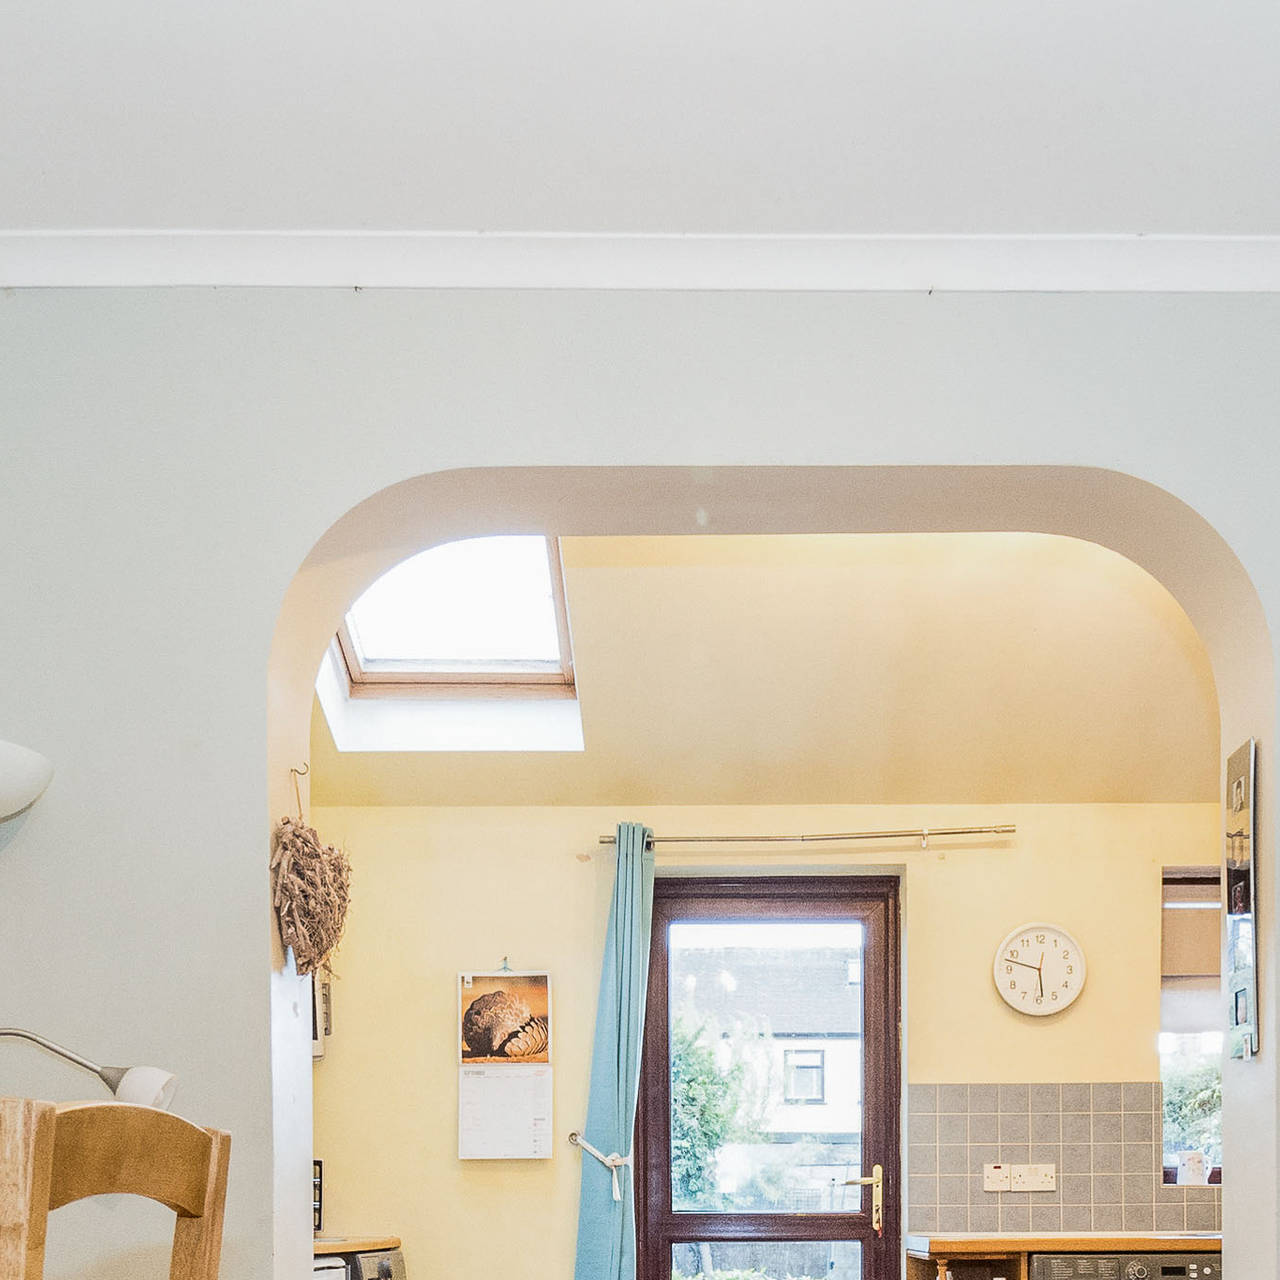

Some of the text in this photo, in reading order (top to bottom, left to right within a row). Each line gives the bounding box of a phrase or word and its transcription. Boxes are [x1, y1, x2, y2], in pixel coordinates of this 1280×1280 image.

[1021, 939, 1029, 948] 11
[1035, 935, 1045, 944] 12
[1009, 950, 1019, 959] 10
[1062, 950, 1069, 960] 2
[1006, 965, 1012, 974] 9
[1066, 965, 1072, 974] 3
[1010, 980, 1016, 989] 8
[1062, 980, 1068, 988] 4
[1021, 991, 1027, 1000] 7
[1035, 995, 1042, 1005] 6
[1051, 991, 1057, 1001] 5
